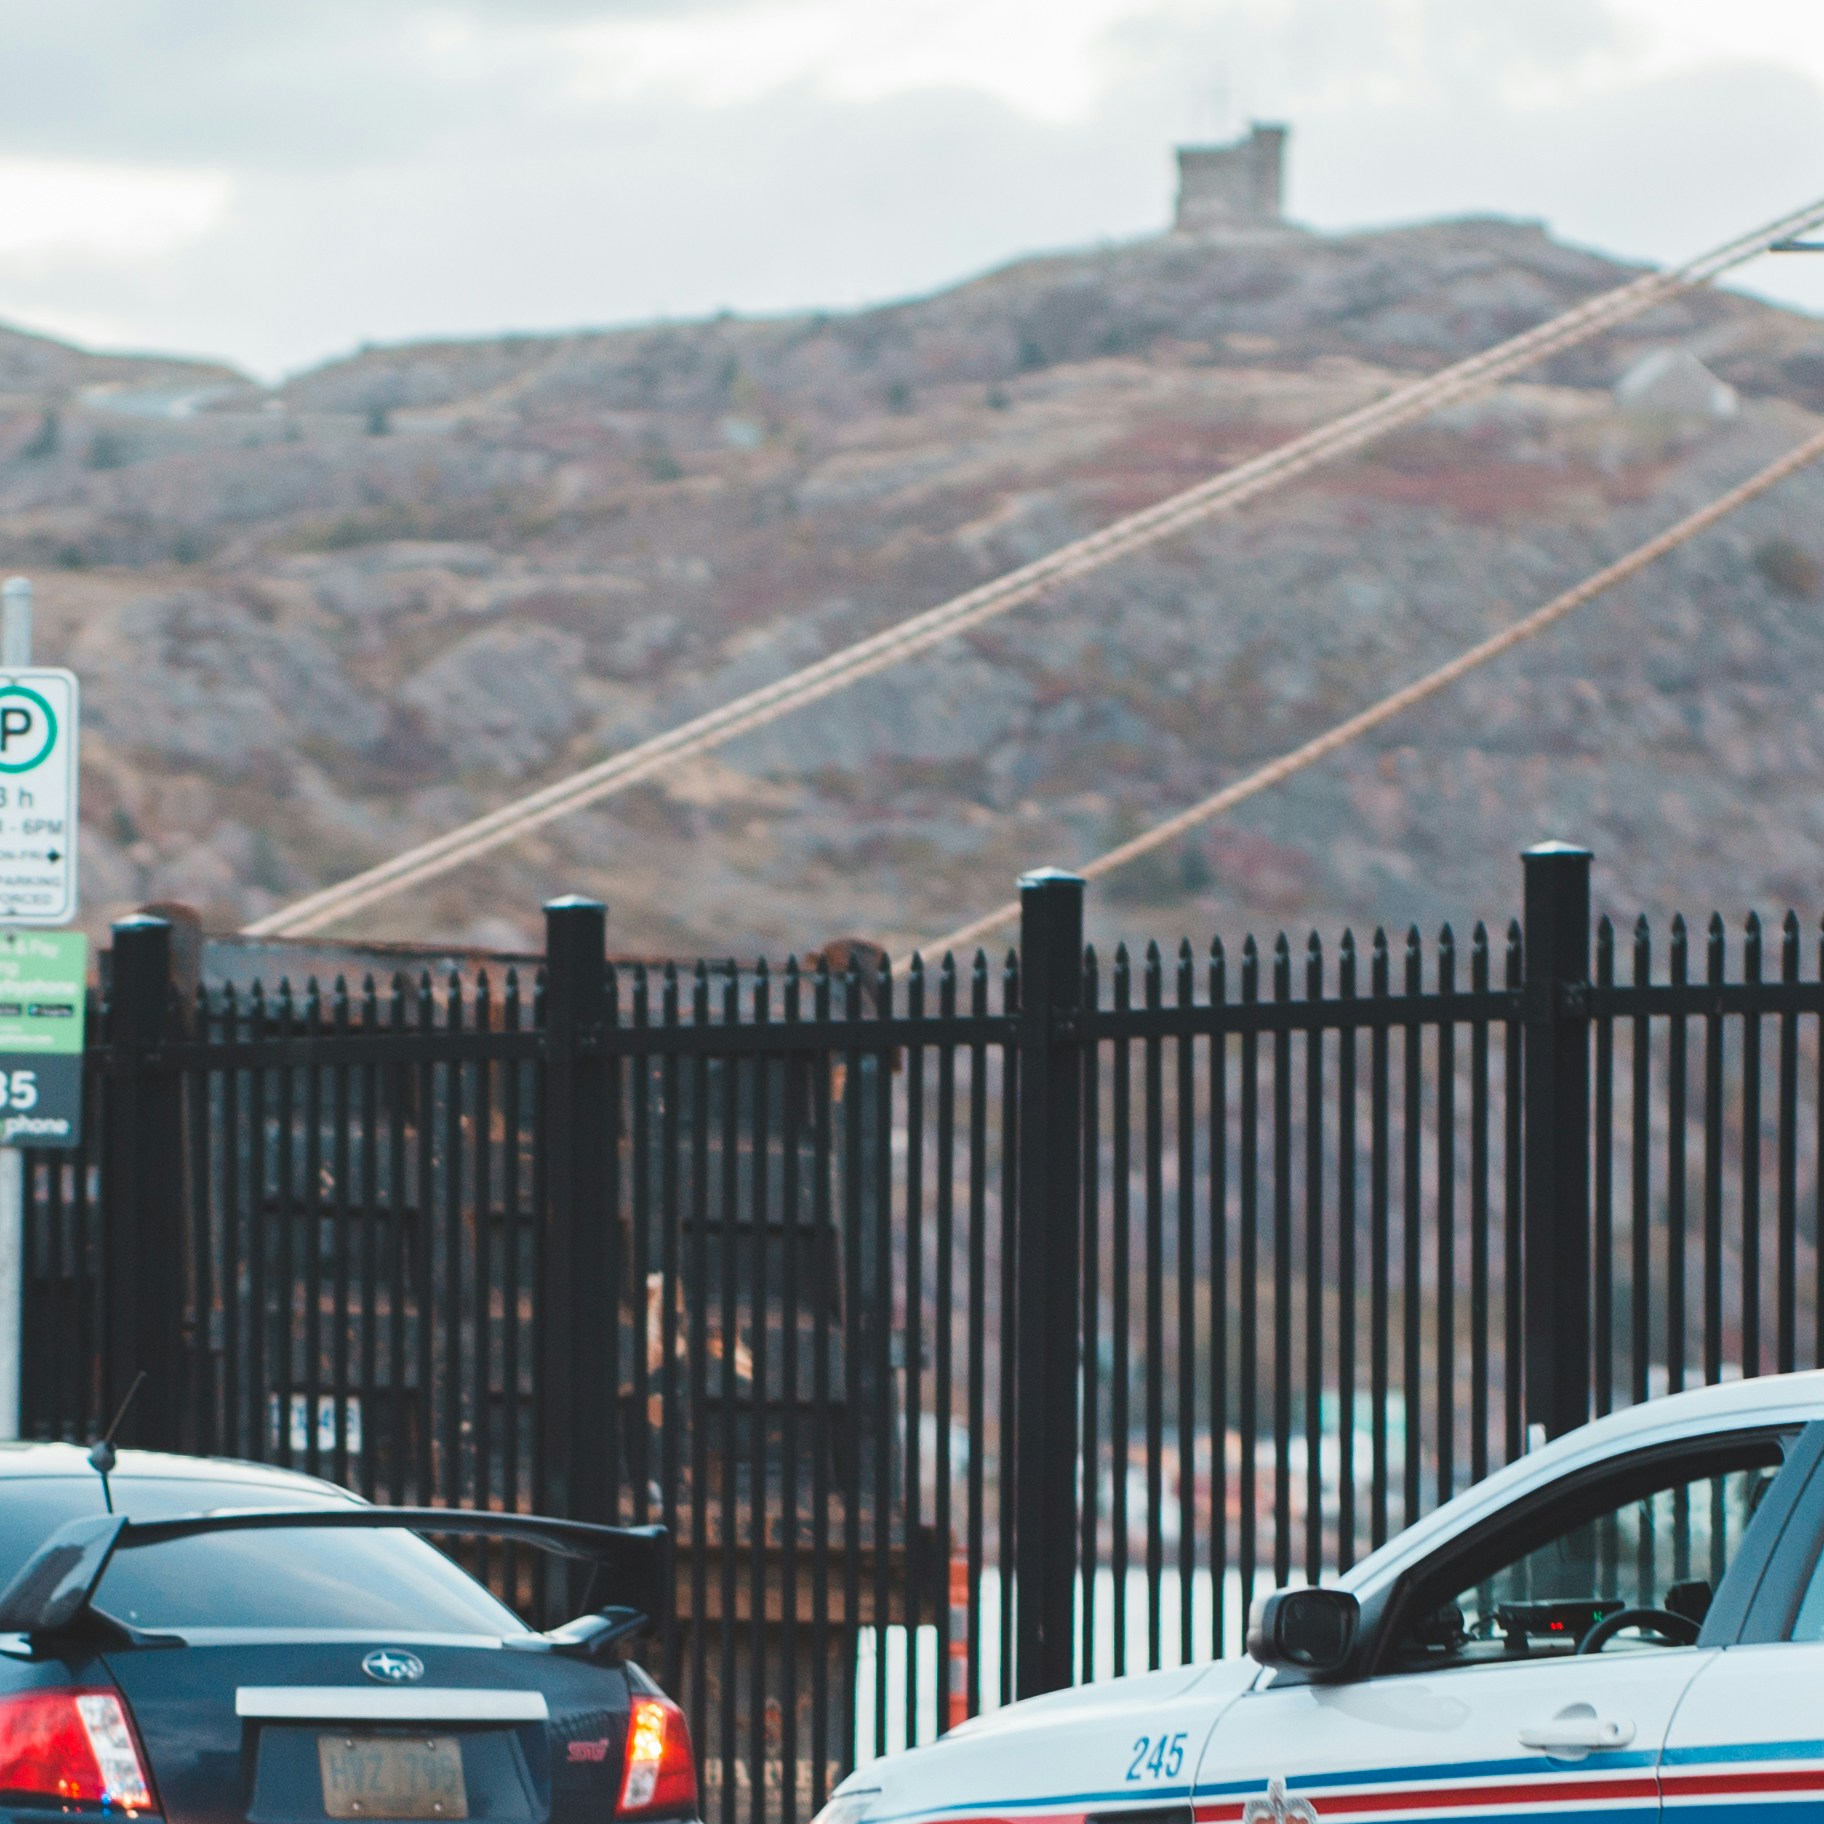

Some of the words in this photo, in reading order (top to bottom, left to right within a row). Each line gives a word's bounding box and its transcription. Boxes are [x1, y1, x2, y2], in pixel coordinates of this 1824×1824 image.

[0, 707, 32, 752] P
[18, 786, 34, 808] h
[22, 819, 64, 835] 6PM
[1126, 1732, 1188, 1781] 245
